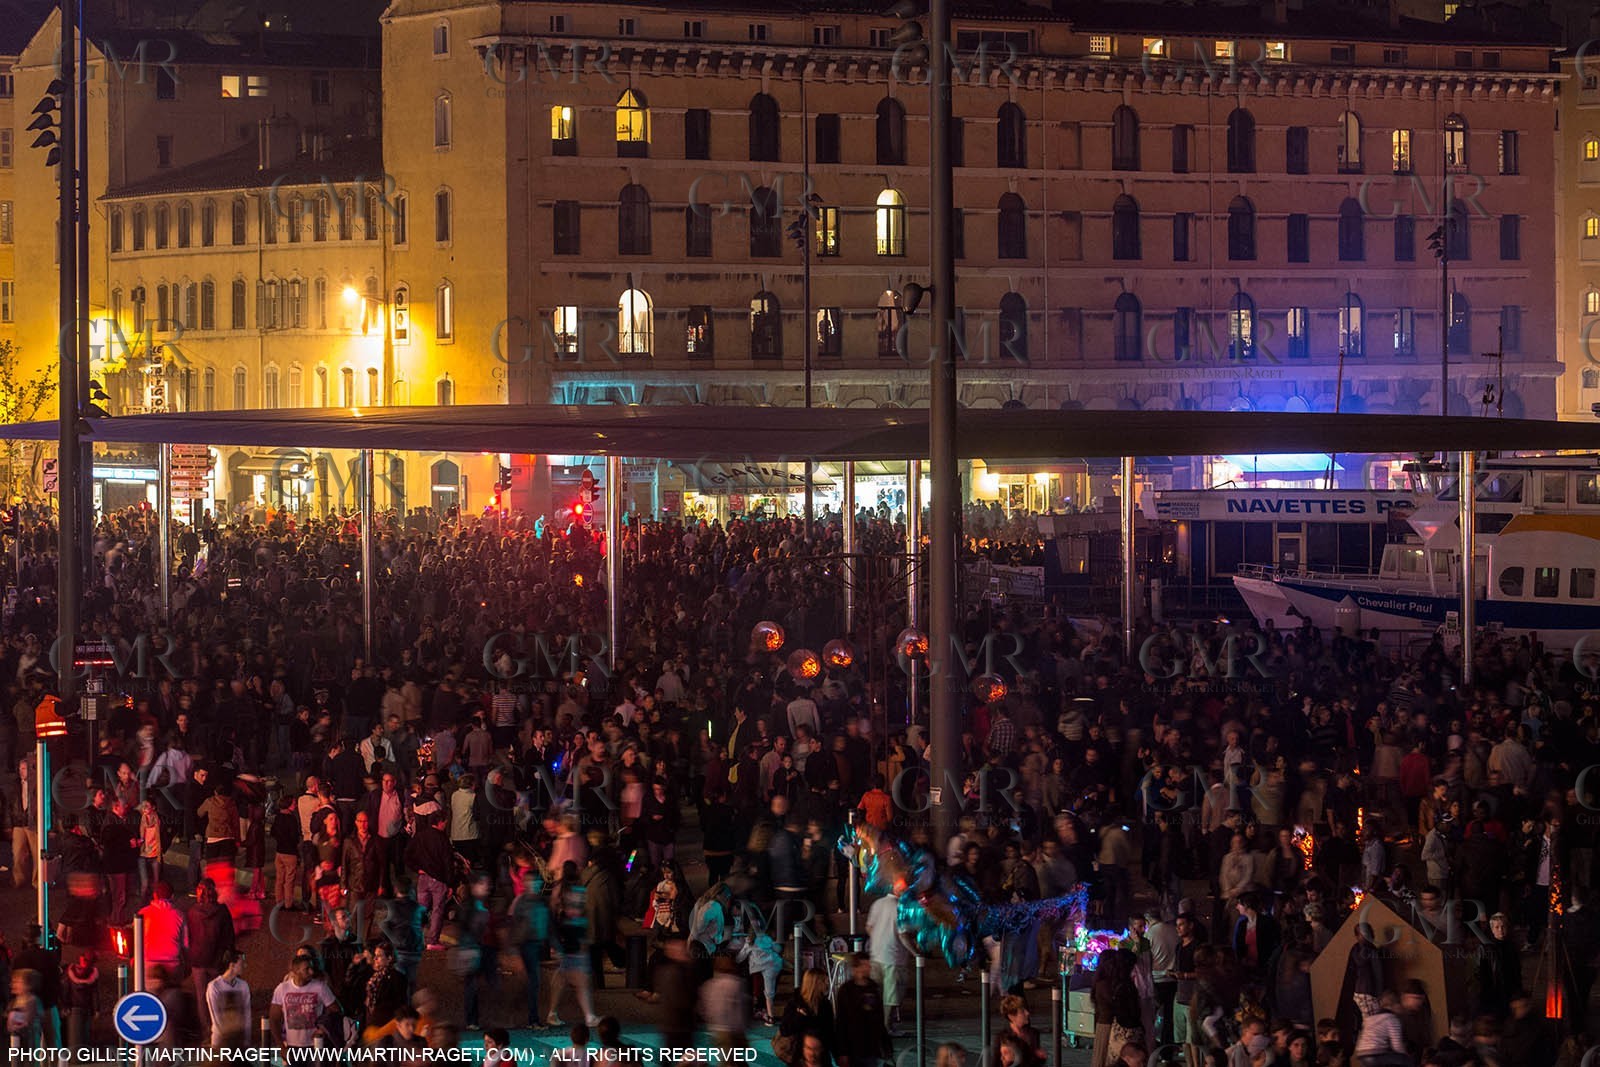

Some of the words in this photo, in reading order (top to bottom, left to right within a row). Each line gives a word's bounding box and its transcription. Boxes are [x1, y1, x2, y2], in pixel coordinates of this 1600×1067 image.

[711, 466, 806, 484] GLACIER
[1227, 499, 1366, 514] NAVETTES
[1357, 596, 1406, 610] Chevalier
[1408, 601, 1433, 614] Paul
